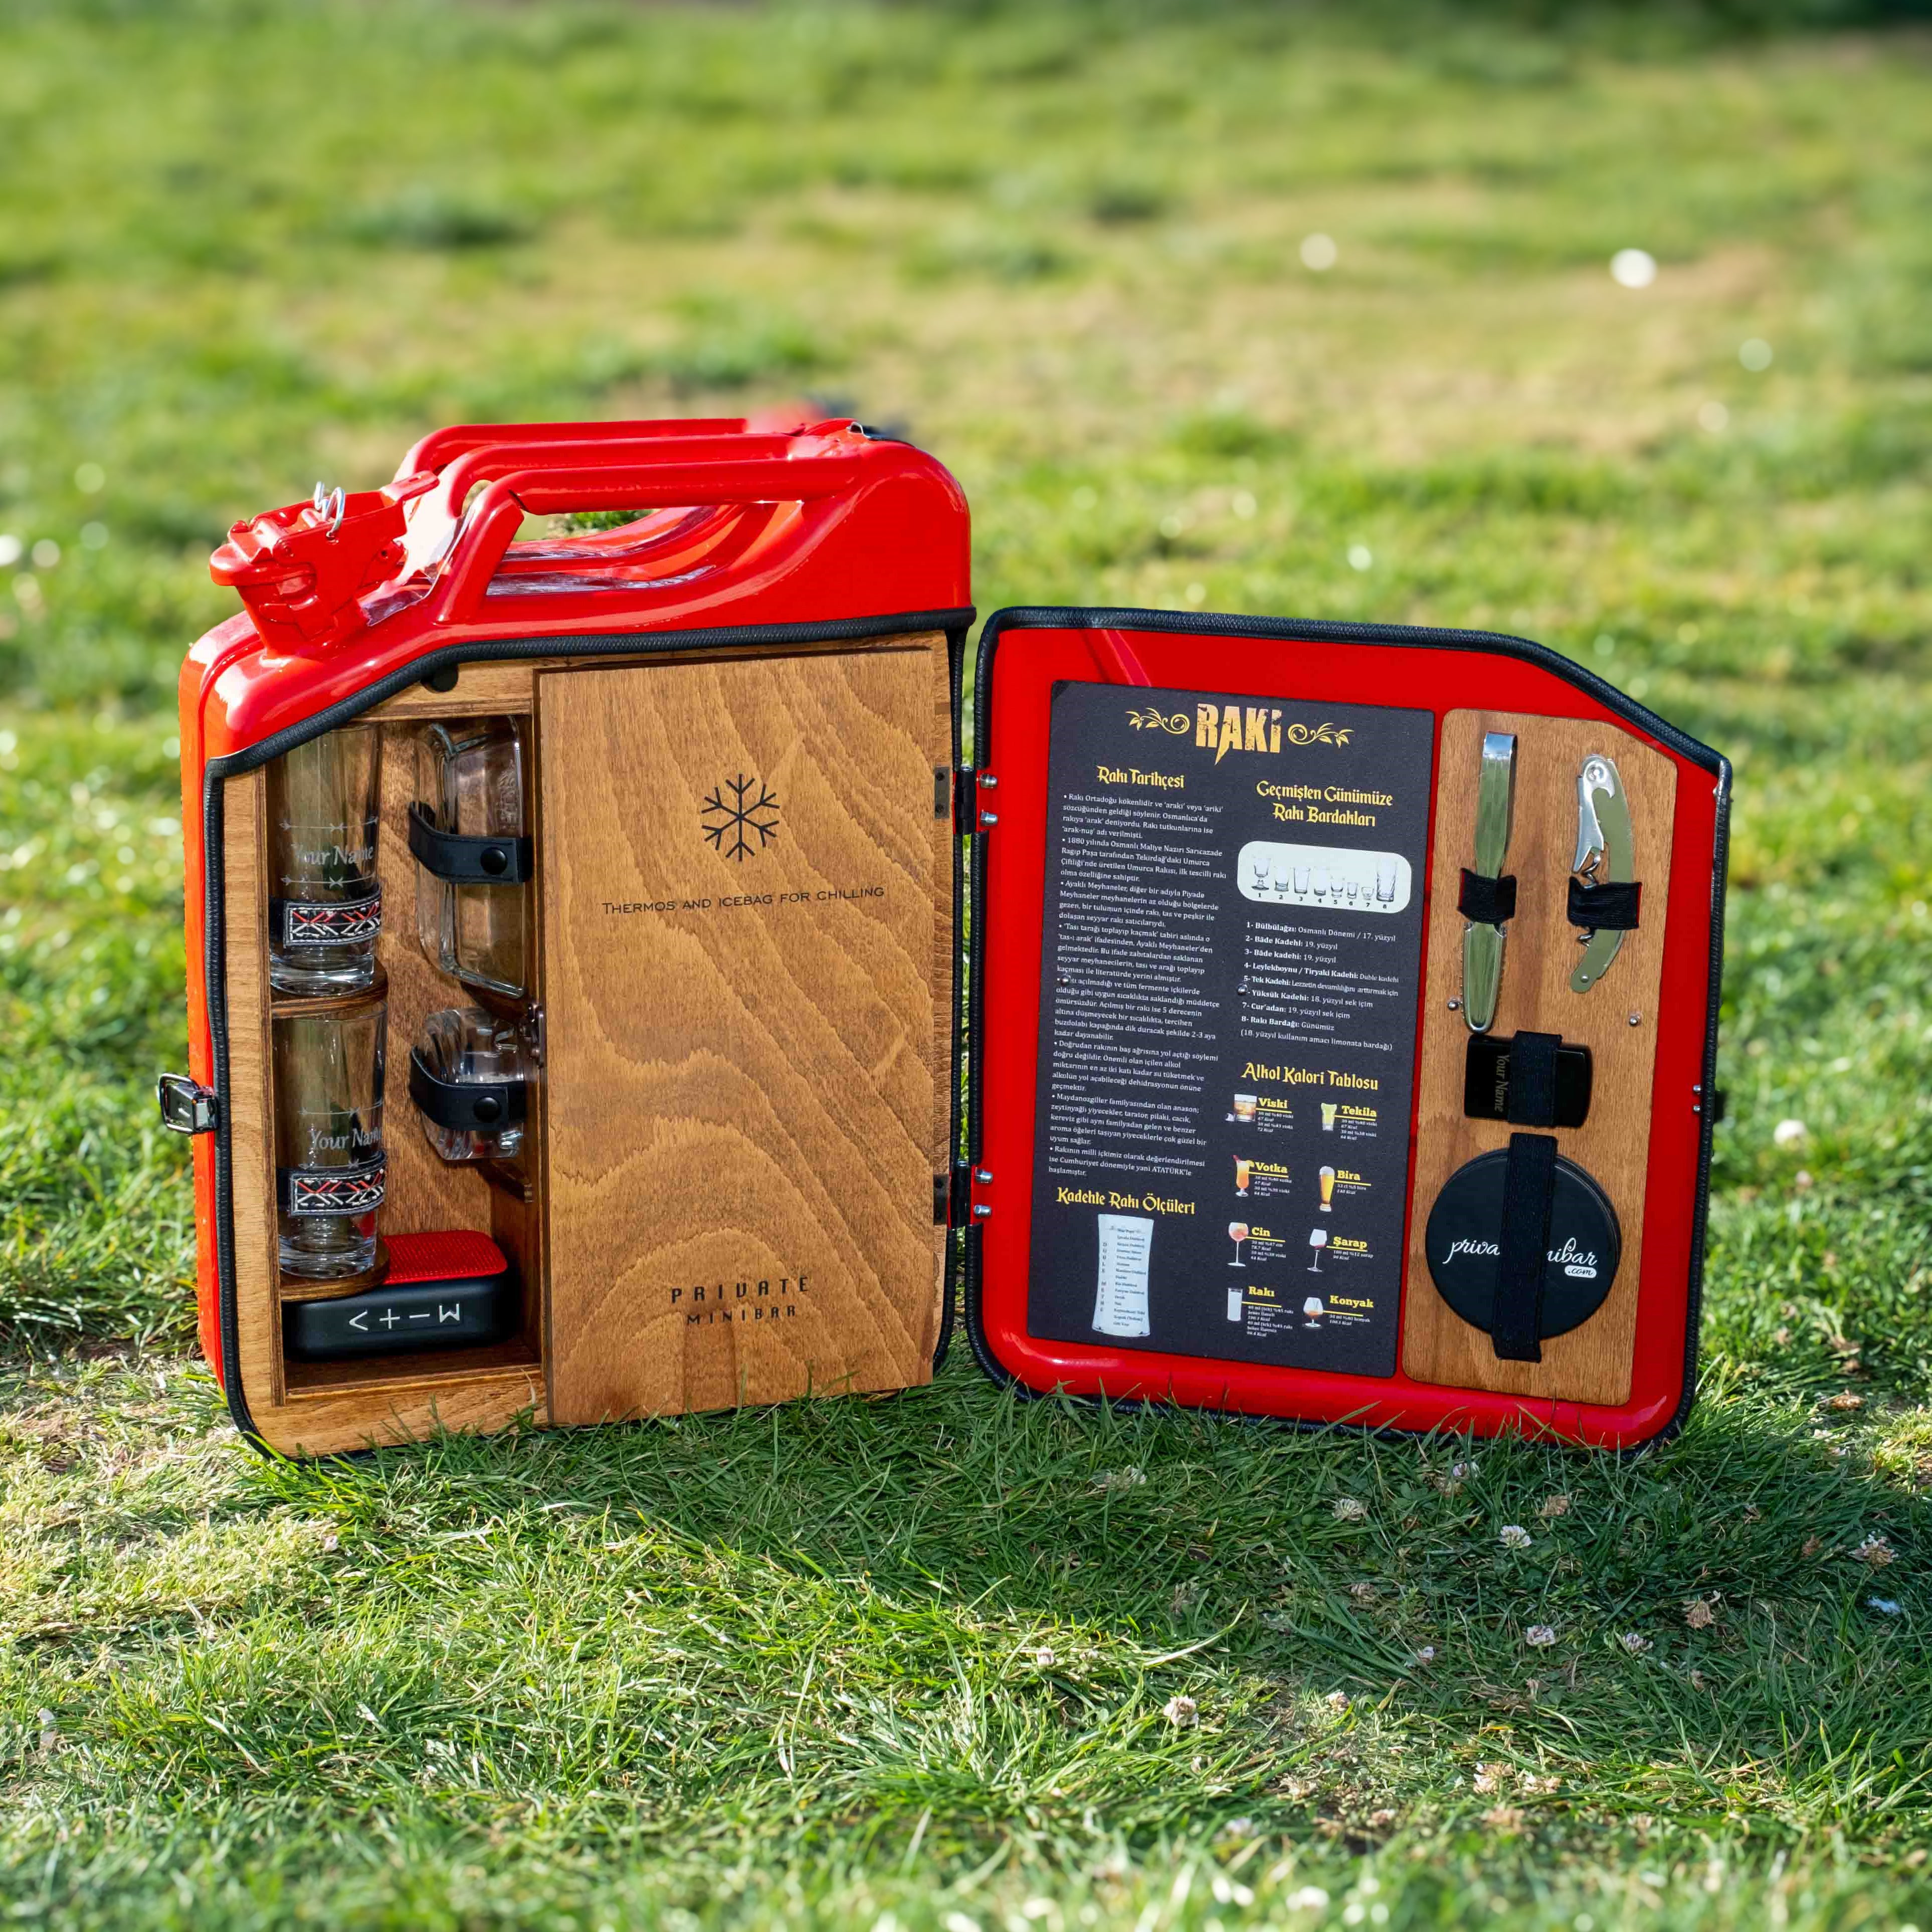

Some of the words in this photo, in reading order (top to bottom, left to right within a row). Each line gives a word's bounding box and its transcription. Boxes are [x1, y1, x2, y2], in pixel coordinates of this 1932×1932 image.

[1097, 766, 1128, 785] Rakı
[1129, 769, 1185, 789] Tarihçesi
[1255, 780, 1322, 800] Geçmişten
[1322, 786, 1394, 806] Günümüze
[1273, 802, 1304, 821] Rakı
[1307, 806, 1376, 827] Bardakları
[682, 898, 711, 909] AND
[719, 894, 773, 907] ICEBAG
[780, 892, 810, 902] FOR
[817, 886, 884, 900] CHILLING
[1241, 1062, 1281, 1081] Alkol
[1283, 1067, 1324, 1084] Kalori
[1327, 1070, 1379, 1092] Tablosu
[1496, 1055, 1510, 1080] Your
[1259, 1098, 1287, 1108] Viski
[1494, 1080, 1509, 1112] Name
[1341, 1105, 1377, 1117] Tekila
[308, 1130, 349, 1149] Your
[352, 1127, 381, 1147] Nam
[1255, 1162, 1287, 1173] Votka
[1337, 1170, 1361, 1180] Bira
[1056, 1187, 1104, 1205] Kadehte
[1109, 1192, 1140, 1210] Rakı
[1140, 1193, 1196, 1215] Ölçüleri
[1251, 1227, 1270, 1237] Cin
[1333, 1236, 1368, 1249] Şarap
[671, 1276, 809, 1303] PRIVATE
[1249, 1286, 1274, 1298] Rakı
[1329, 1294, 1374, 1308] Konyak
[687, 1305, 796, 1324] MINIBAR
